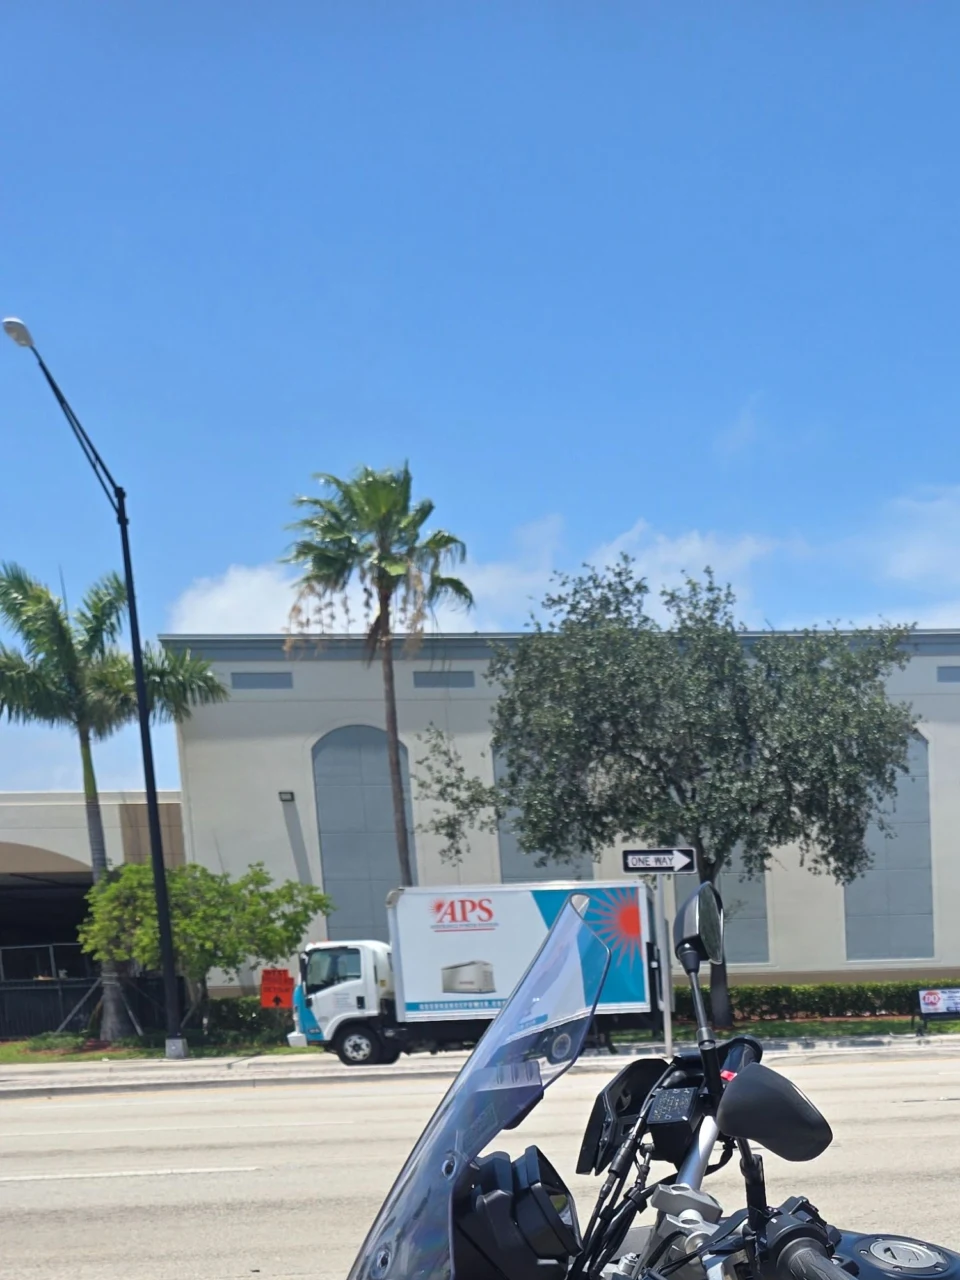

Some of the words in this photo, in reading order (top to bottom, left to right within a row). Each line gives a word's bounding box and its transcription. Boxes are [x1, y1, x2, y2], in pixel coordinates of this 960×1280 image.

[631, 856, 651, 867] ONE
[654, 856, 674, 866] WAY
[436, 898, 494, 923] APS
